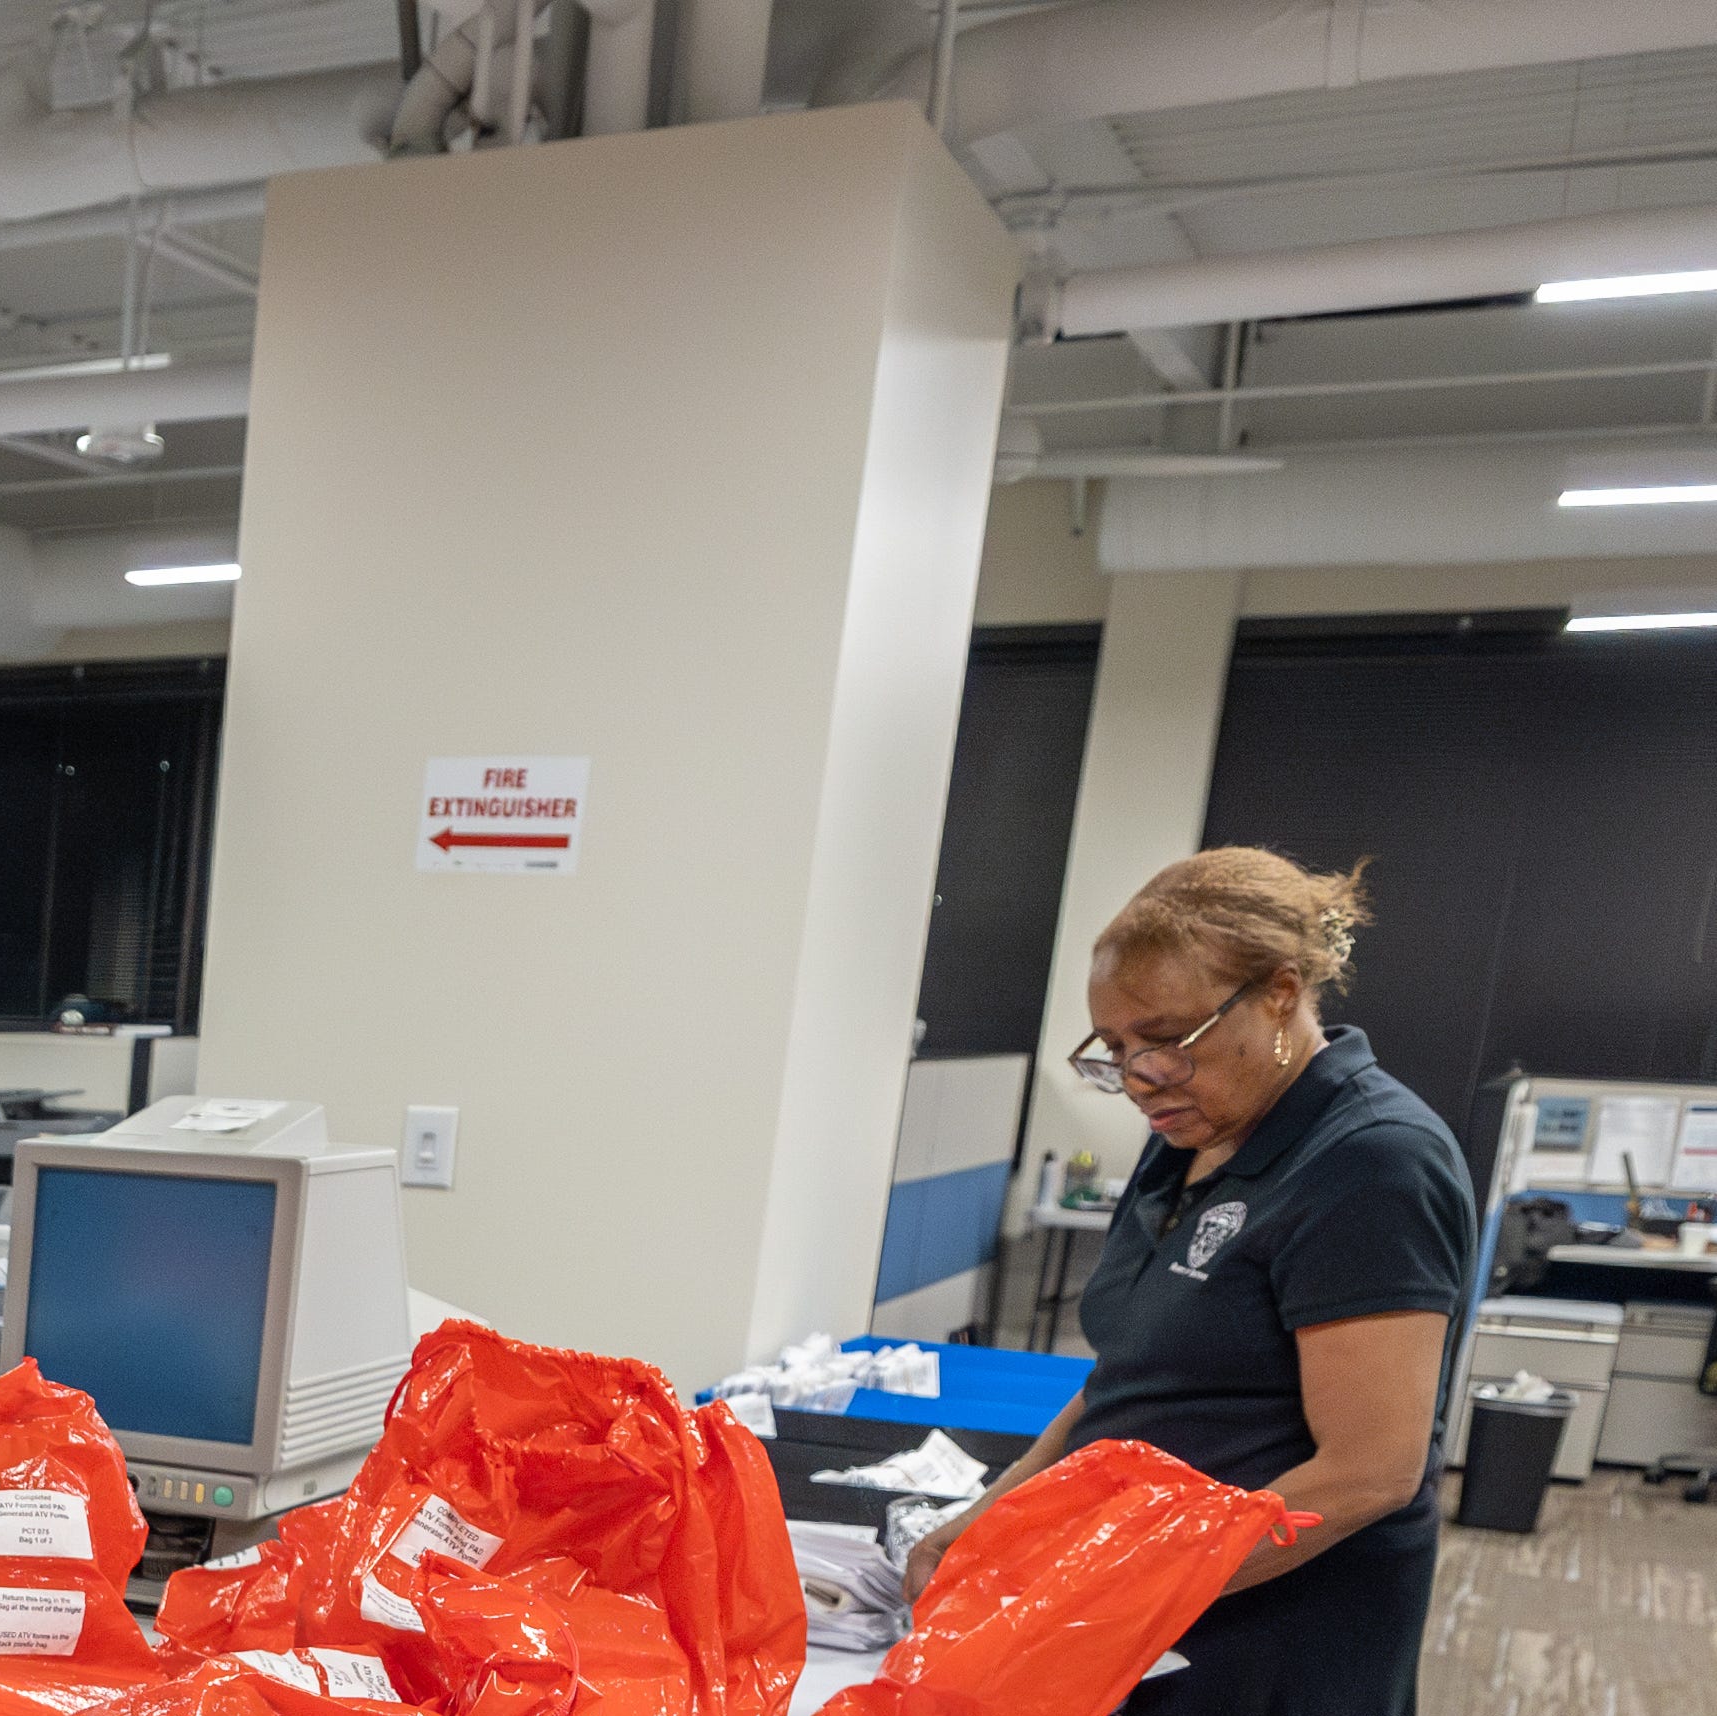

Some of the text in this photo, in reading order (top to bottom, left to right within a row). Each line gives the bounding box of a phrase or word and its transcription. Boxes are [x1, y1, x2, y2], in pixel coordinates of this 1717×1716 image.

[482, 767, 528, 790] FIRE
[428, 797, 577, 818] EXTINGUISHER
[15, 1494, 52, 1502] Completed
[413, 1517, 443, 1540] enerated
[443, 1536, 461, 1550] ATV
[437, 1506, 480, 1541] COMPLETED
[19, 1536, 33, 1545] Bag
[468, 1543, 485, 1555] PAD
